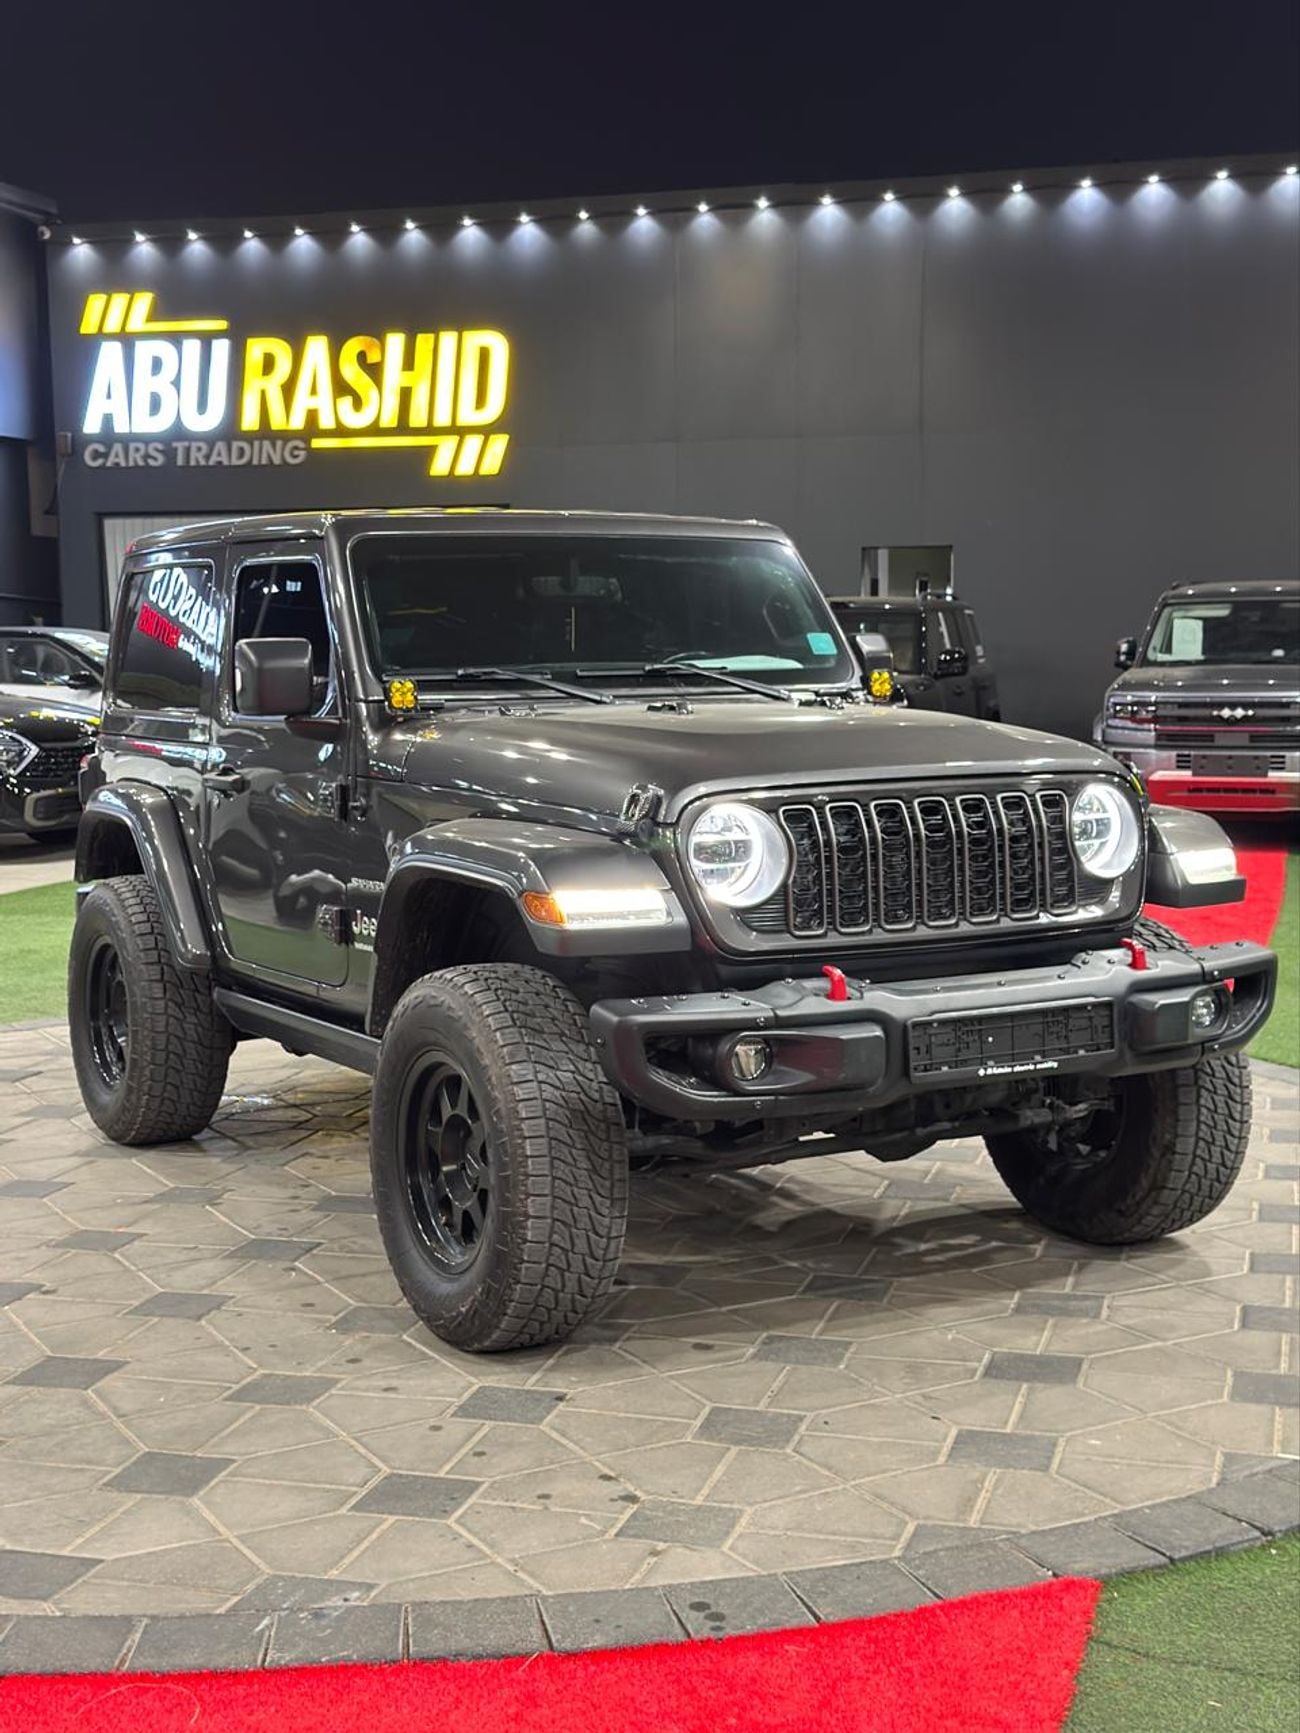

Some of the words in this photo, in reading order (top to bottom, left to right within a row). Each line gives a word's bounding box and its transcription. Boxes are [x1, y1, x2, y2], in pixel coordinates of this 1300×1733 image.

[82, 338, 230, 434] ABU
[240, 329, 509, 431] RASHID
[83, 441, 165, 468] CARS
[172, 440, 308, 466] TRADING
[352, 909, 378, 938] Jee
